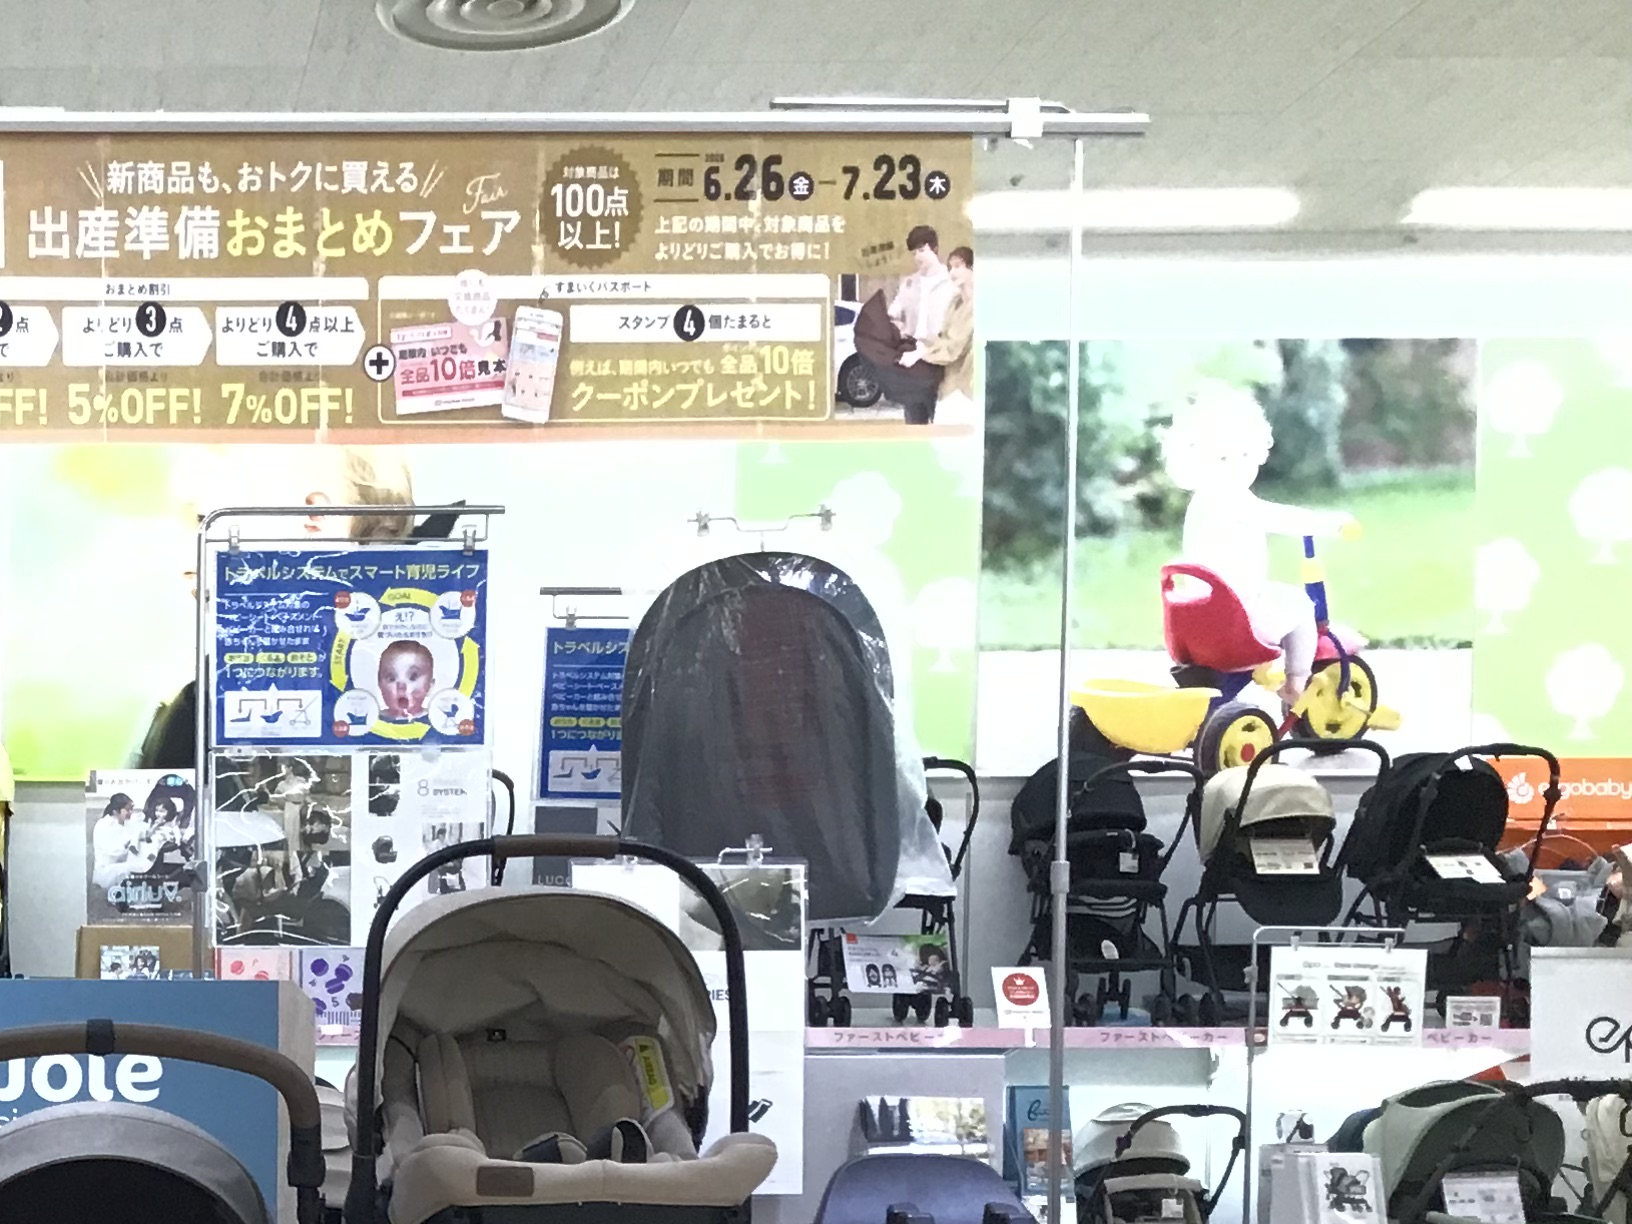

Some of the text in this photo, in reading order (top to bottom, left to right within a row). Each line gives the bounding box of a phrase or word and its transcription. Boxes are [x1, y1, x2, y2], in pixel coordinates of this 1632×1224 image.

[107, 160, 419, 195] 新商品も、おトクに買える
[657, 168, 694, 187] 期間
[551, 183, 629, 217] 100点
[28, 205, 521, 260] 出産準備おまとめフェア
[104, 341, 163, 358] ご購入で
[257, 341, 318, 358] ご購入で
[68, 384, 202, 426] 5%OFF!
[221, 384, 353, 426] 7%OFF!
[1538, 778, 1632, 800] egobaby
[834, 1032, 944, 1042] ファーストベビー
[1100, 1032, 1227, 1042] ファーストベーカー
